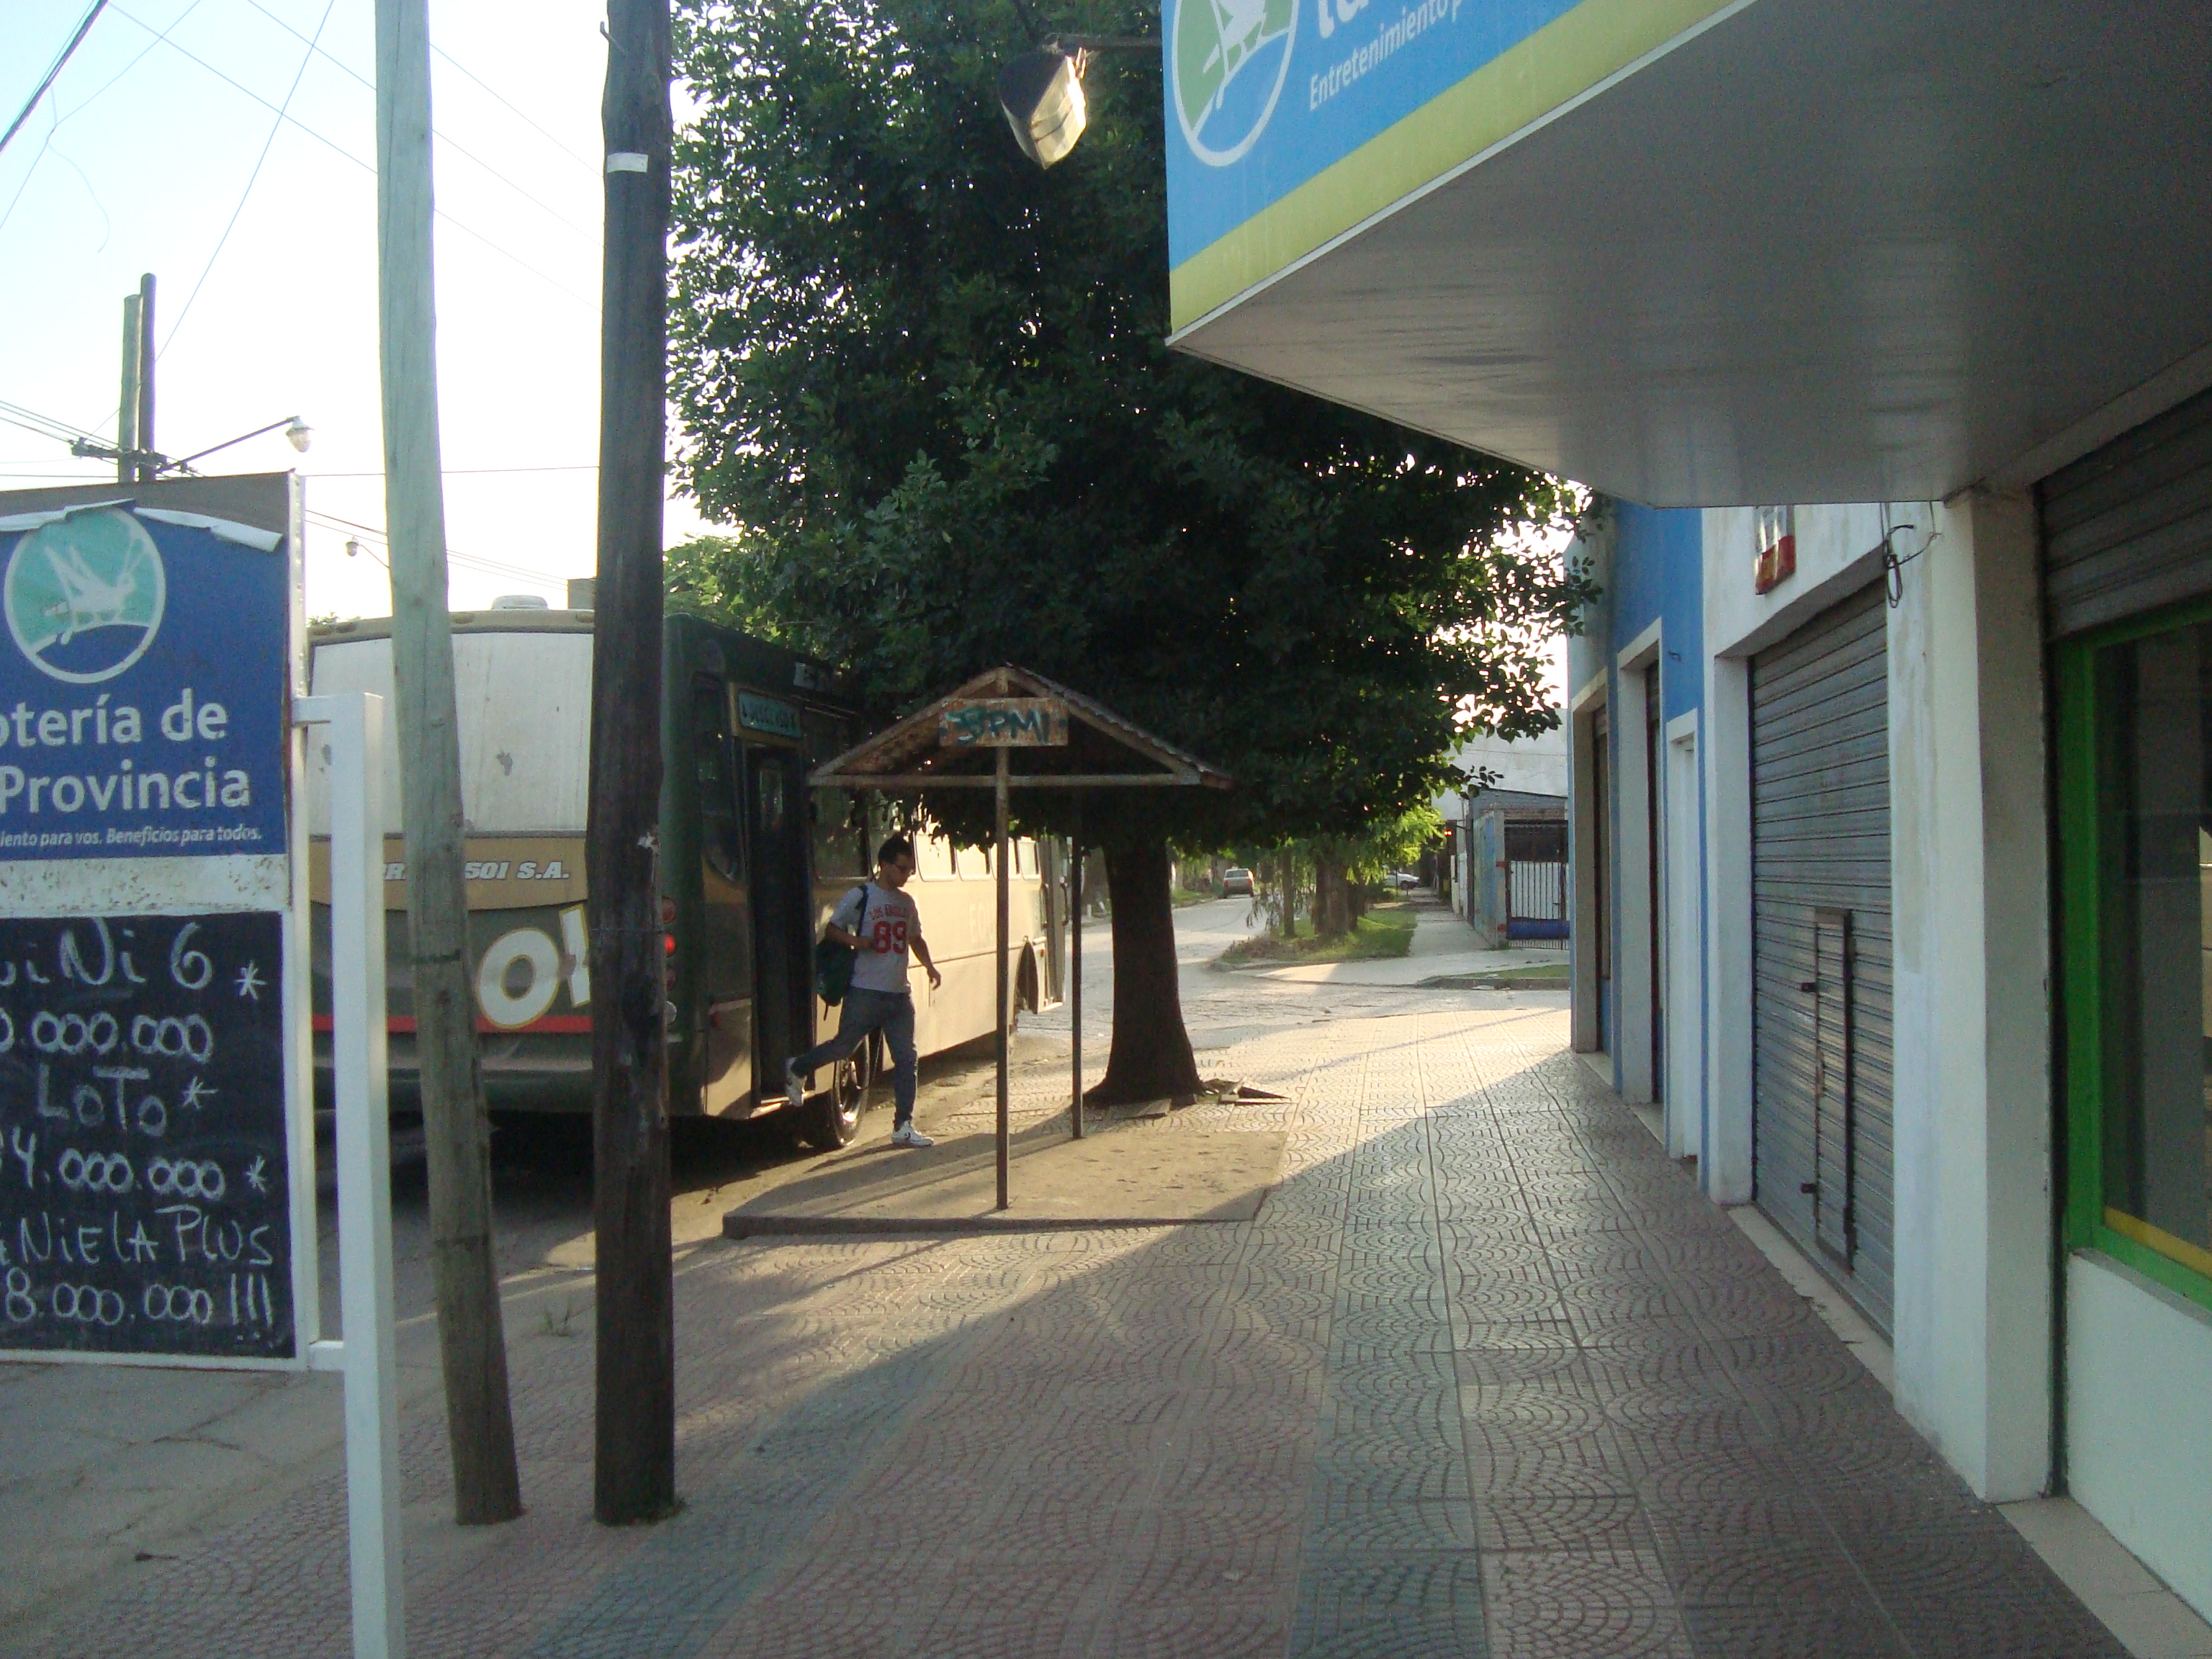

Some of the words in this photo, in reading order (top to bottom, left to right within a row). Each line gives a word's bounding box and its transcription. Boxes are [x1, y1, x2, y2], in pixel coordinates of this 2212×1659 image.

[1309, 0, 1449, 111] Entretenimiento
[161, 687, 228, 741] de
[0, 756, 250, 814] Provincia
[40, 831, 71, 848] para
[107, 826, 179, 847] Beneficios
[180, 827, 214, 847] para
[217, 823, 262, 842] todos.
[517, 860, 570, 880] S.A.
[170, 922, 213, 991] 6
[873, 920, 908, 954] 89
